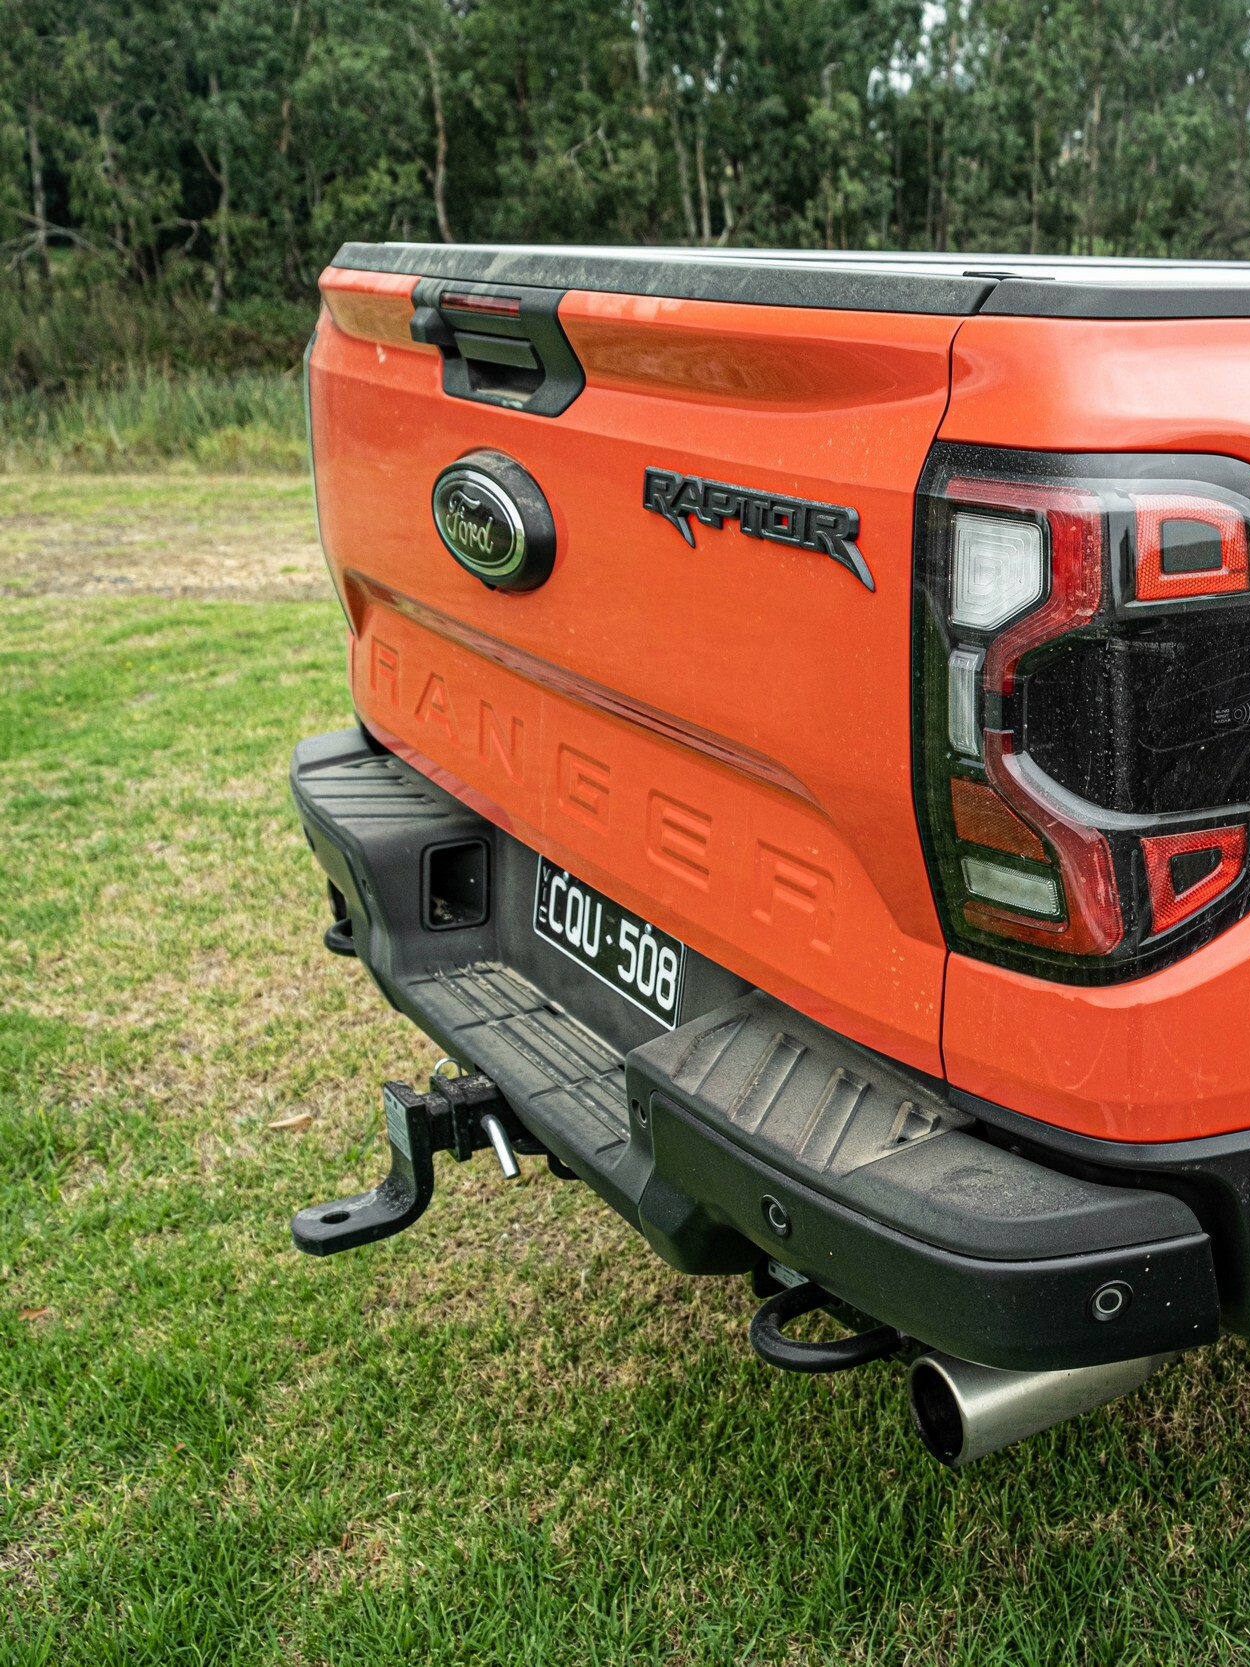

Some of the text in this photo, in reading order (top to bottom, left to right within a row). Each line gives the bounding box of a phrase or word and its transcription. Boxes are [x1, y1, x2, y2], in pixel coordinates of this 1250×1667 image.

[445, 490, 494, 556] Ford
[642, 465, 876, 593] RAPTOR
[370, 636, 837, 956] RANGER
